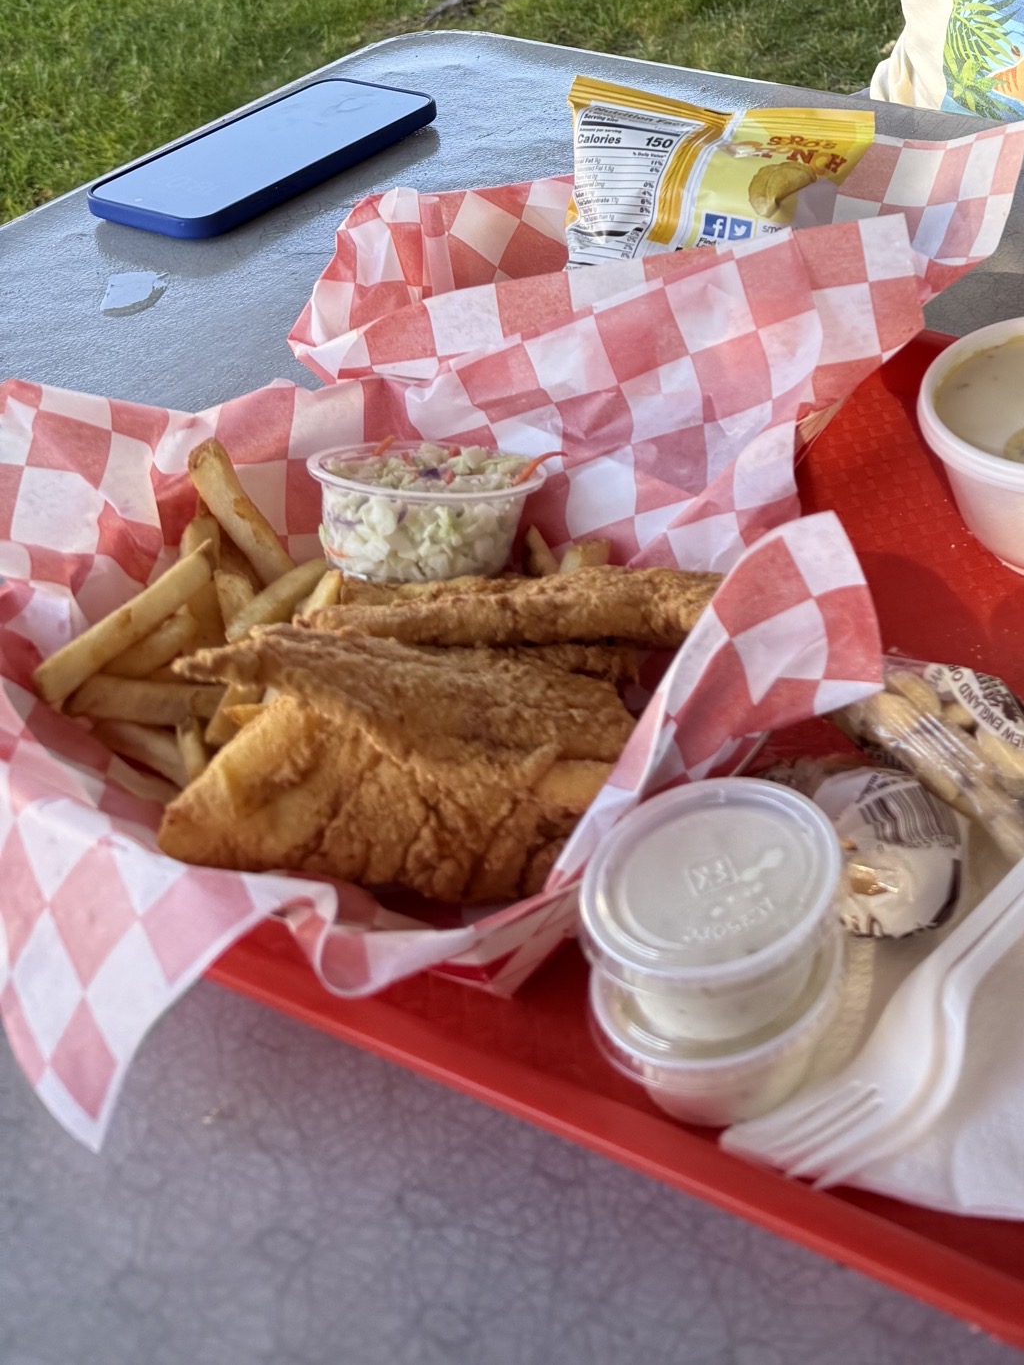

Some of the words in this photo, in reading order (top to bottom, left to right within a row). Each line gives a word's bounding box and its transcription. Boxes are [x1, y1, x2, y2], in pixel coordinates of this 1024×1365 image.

[584, 113, 606, 121] Serving
[595, 106, 653, 122] Nutrition
[577, 134, 621, 145] Calories
[645, 136, 674, 148] 150
[958, 682, 1005, 732] ENGLAND
